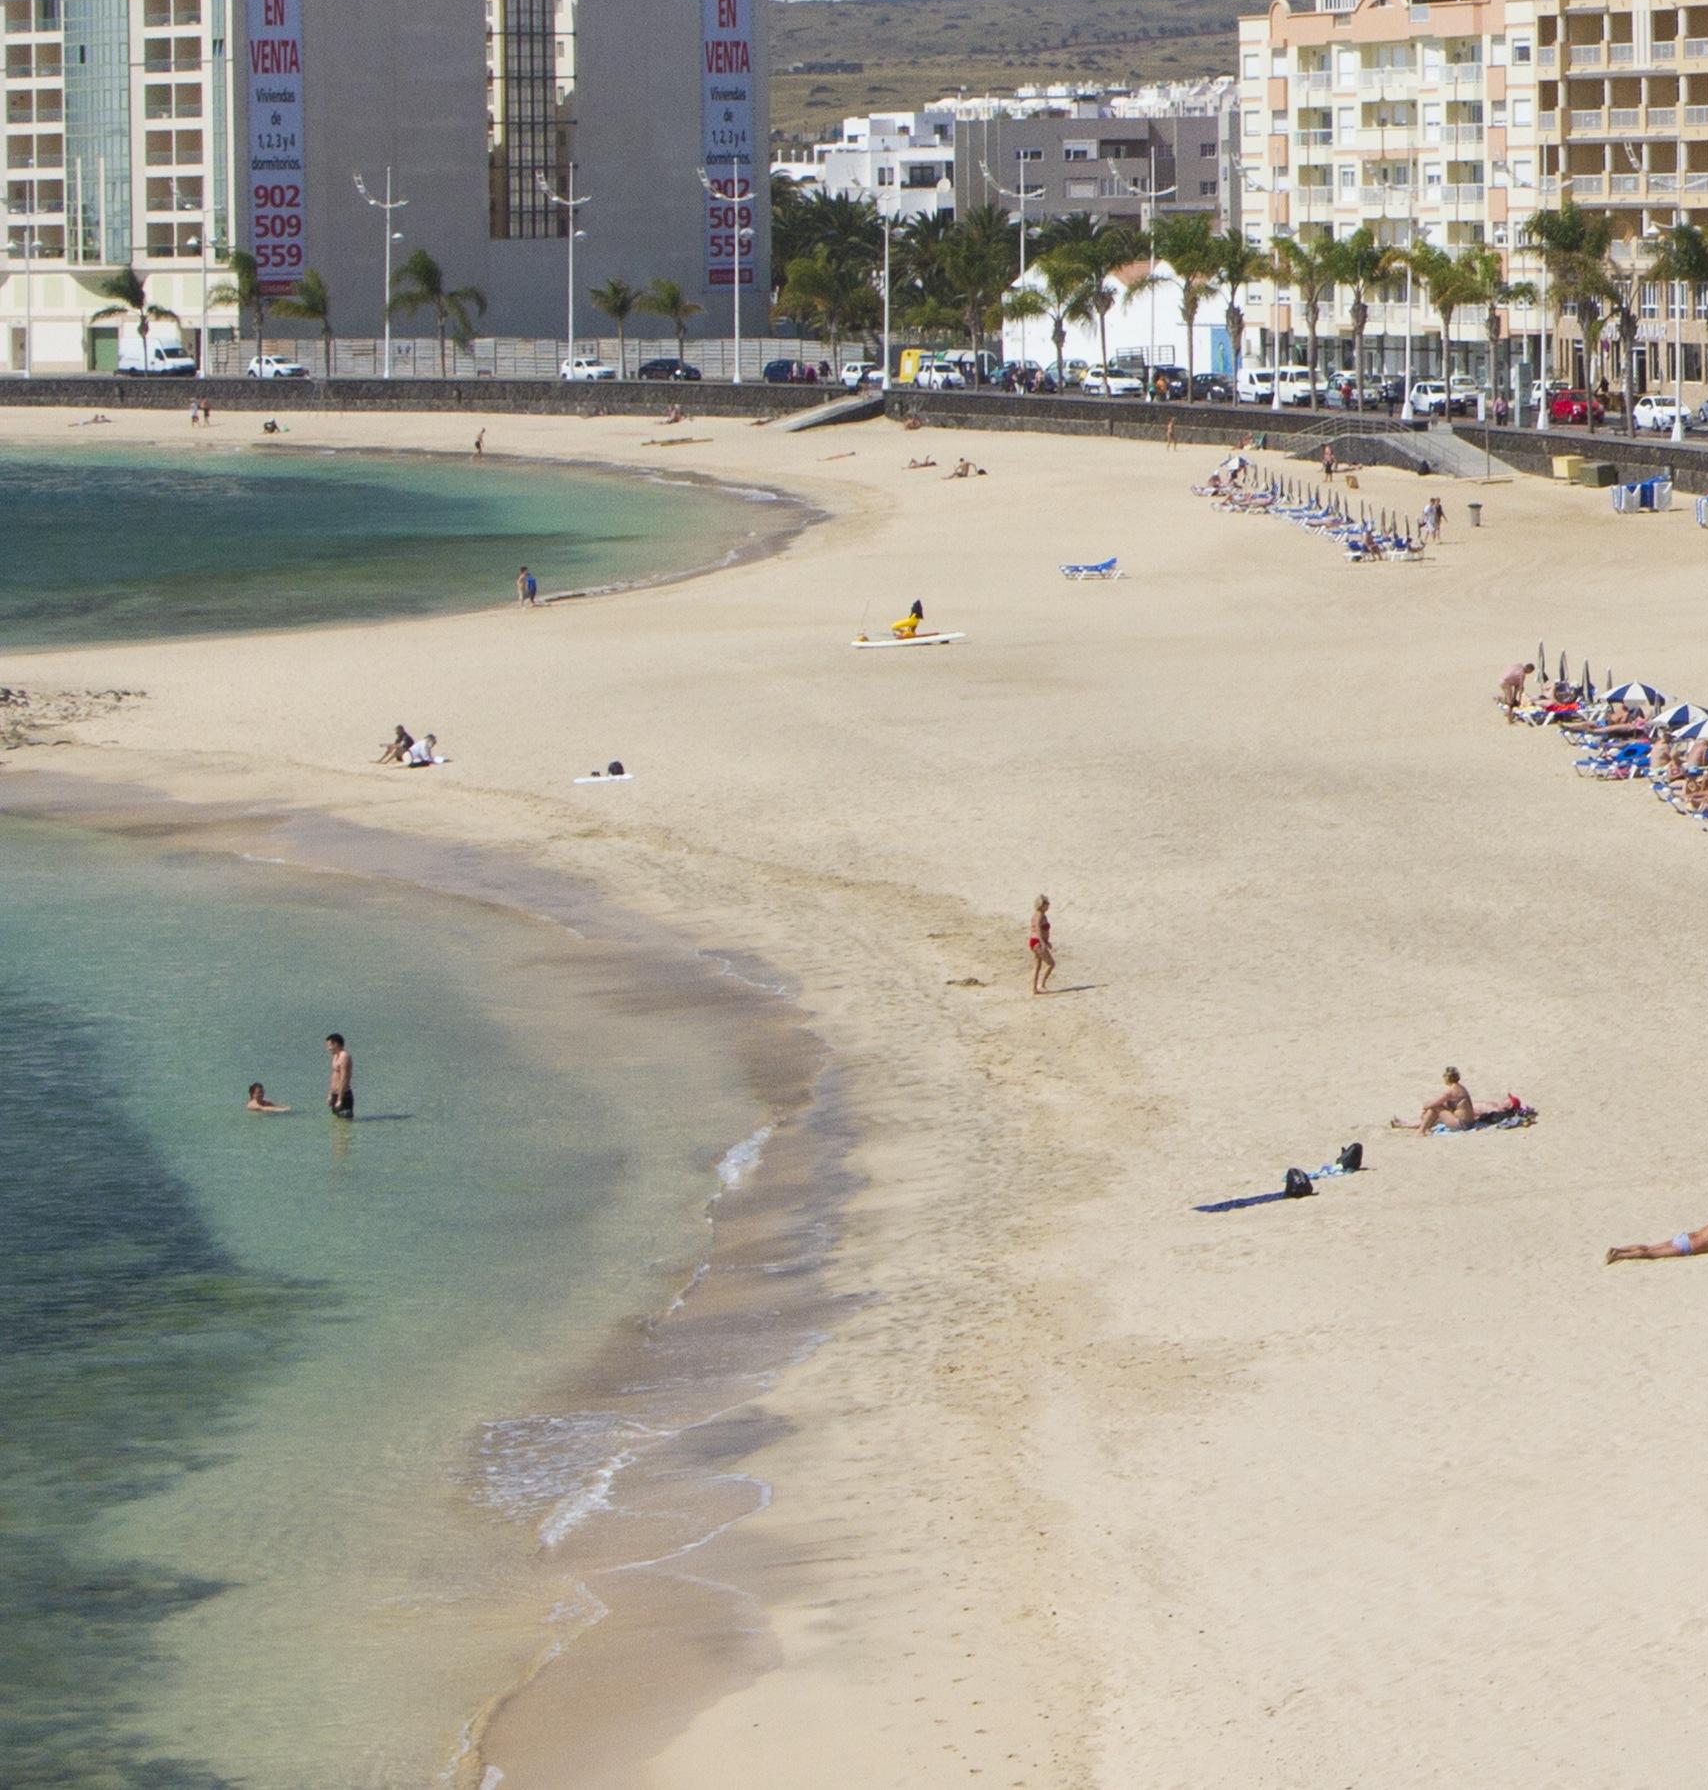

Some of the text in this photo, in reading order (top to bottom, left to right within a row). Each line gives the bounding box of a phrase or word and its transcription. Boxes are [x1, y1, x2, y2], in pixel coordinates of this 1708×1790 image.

[250, 39, 300, 74] VENTA
[705, 41, 751, 74] VENTA
[256, 88, 295, 103] Viviendas
[711, 86, 746, 101] Viviendas
[270, 110, 282, 126] de
[723, 109, 733, 122] de
[254, 184, 301, 209] 902
[255, 214, 302, 238] 509
[709, 206, 752, 229] 509
[255, 243, 302, 268] 559
[710, 235, 752, 257] 559
